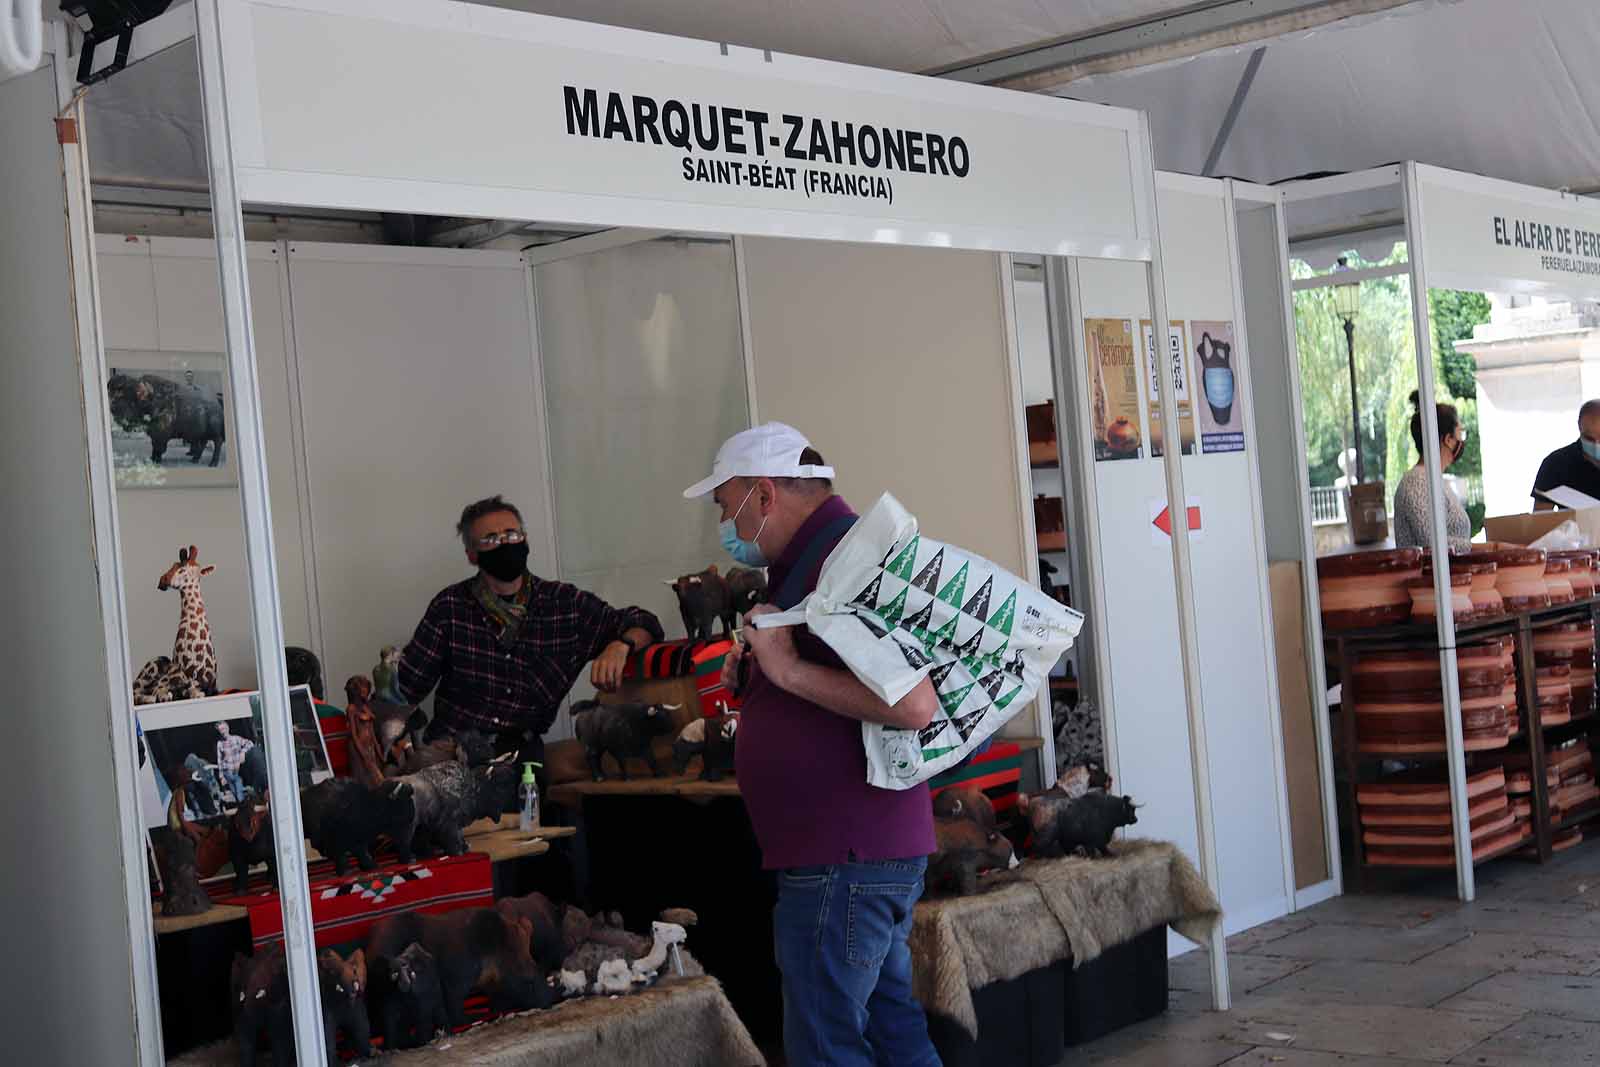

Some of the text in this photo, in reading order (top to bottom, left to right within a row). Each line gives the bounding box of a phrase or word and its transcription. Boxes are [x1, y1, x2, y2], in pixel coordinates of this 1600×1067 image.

[563, 85, 970, 178] MARQUET-ZAHONERO
[683, 157, 893, 204] SAINT-BÉAT (FRANCIA)
[1494, 216, 1511, 246] EL
[1514, 219, 1553, 252] ALFAR
[1556, 226, 1572, 255] DE
